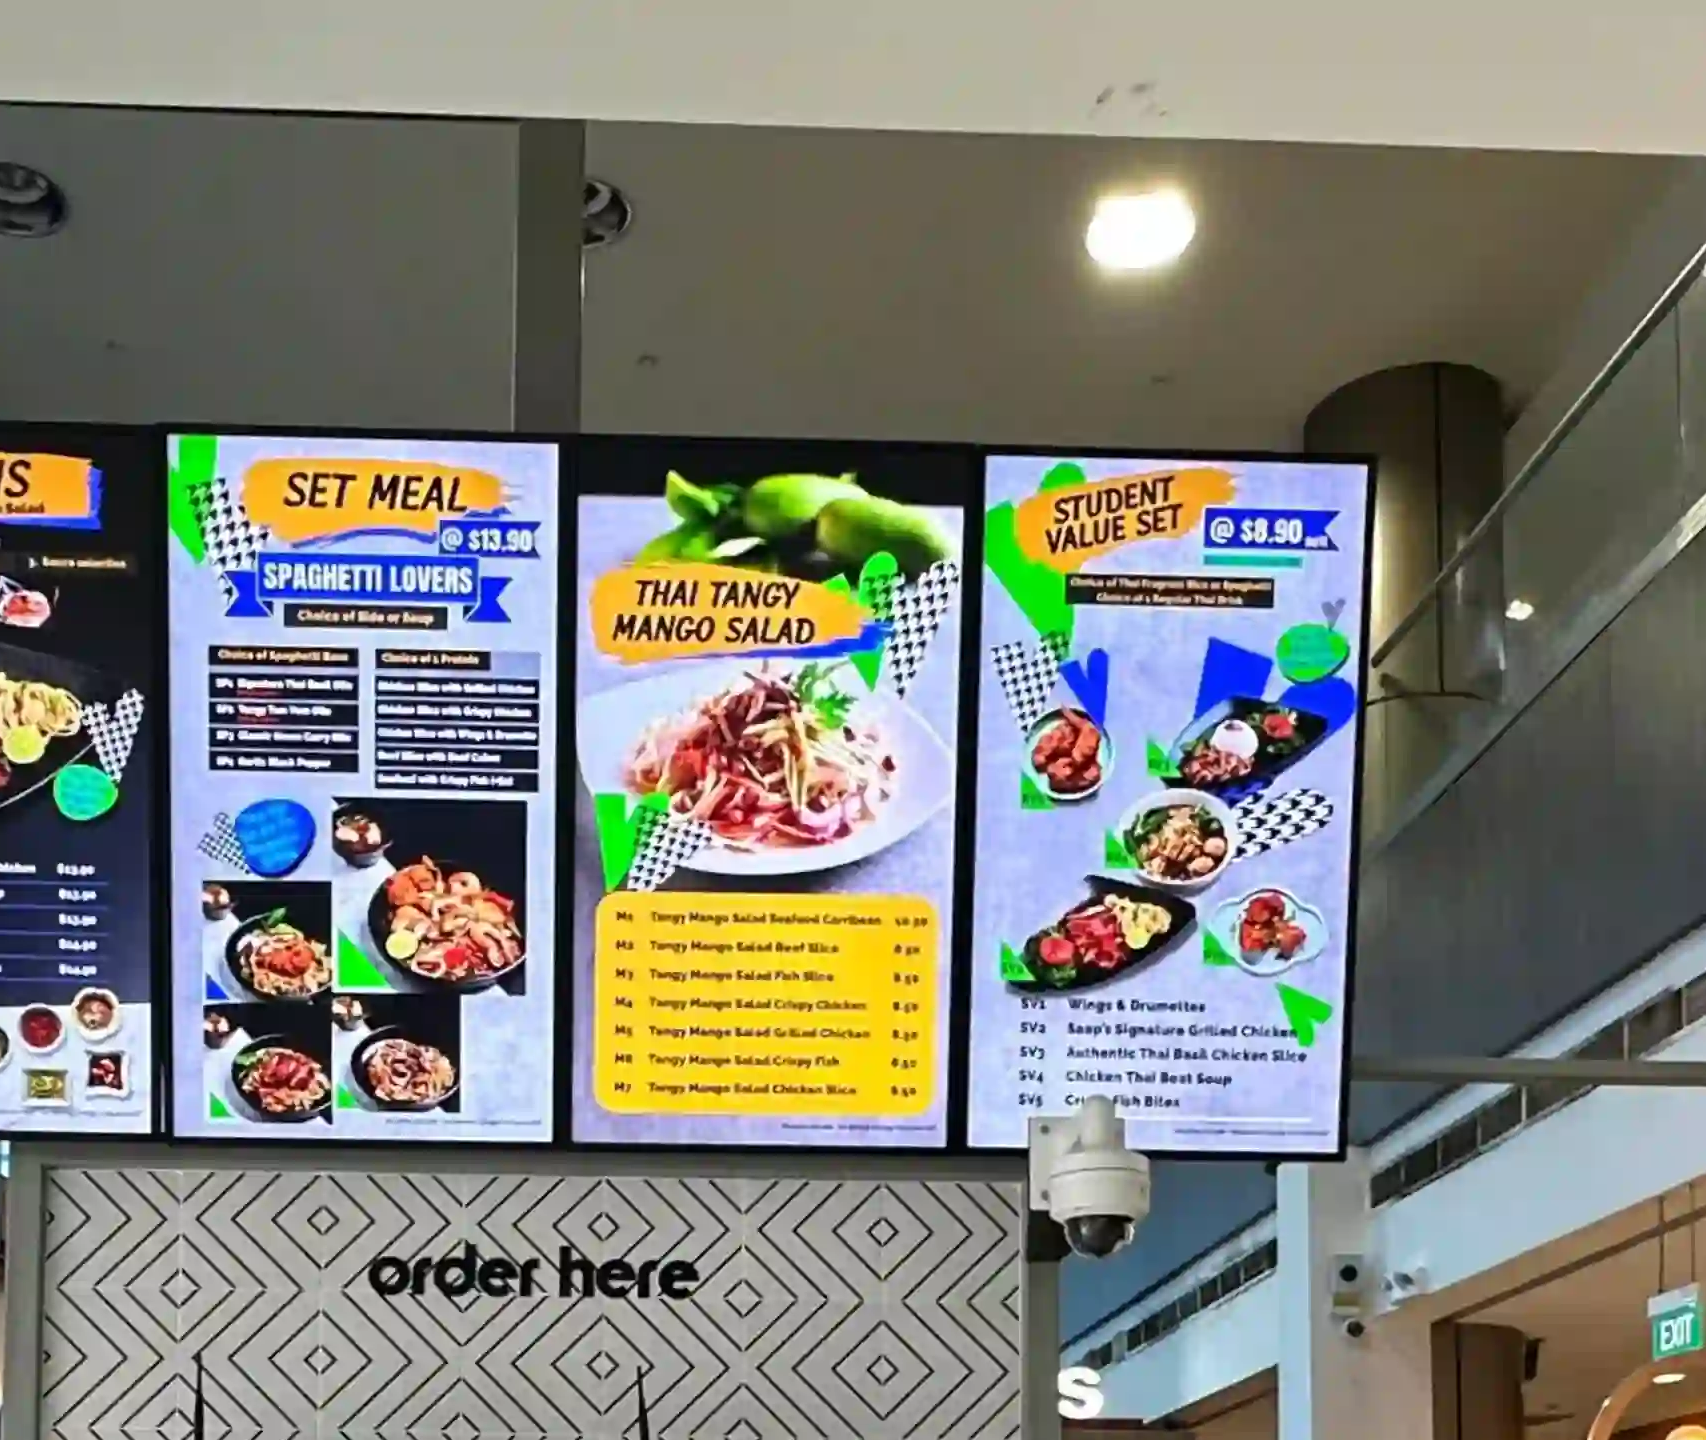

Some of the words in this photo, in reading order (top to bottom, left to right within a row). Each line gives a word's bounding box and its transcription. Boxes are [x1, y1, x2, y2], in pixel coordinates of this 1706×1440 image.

[283, 472, 357, 508] SET
[368, 474, 468, 512] MEAL
[1054, 475, 1175, 525] STUDENT
[442, 529, 464, 550] @
[468, 529, 534, 552] $13.90
[1045, 514, 1126, 555] VALUE
[1137, 504, 1183, 537] SET
[1210, 519, 1234, 543] @
[1241, 518, 1303, 544] $8.90
[262, 563, 382, 592] SPAGHETTI
[390, 566, 473, 594] LOVERS
[636, 580, 698, 607] THAI
[710, 581, 800, 609] TANGY
[613, 615, 716, 642] MANGO
[724, 617, 815, 644] SALAD
[1021, 998, 1046, 1010] SV1
[1068, 999, 1113, 1015] Wings
[1130, 1000, 1206, 1013] Drumettes
[1020, 1022, 1046, 1034] SV2
[1115, 1024, 1185, 1039] Signature
[1189, 1025, 1237, 1038] Grilled
[1241, 1025, 1298, 1038] Chicken
[1020, 1046, 1045, 1059] SV3
[1067, 1047, 1136, 1060] Authentic
[1139, 1048, 1170, 1061] Thai
[1211, 1049, 1267, 1062] Chicken
[1272, 1050, 1307, 1063] Slice
[1019, 1070, 1044, 1083] SV4
[1066, 1071, 1122, 1084] Chicken
[1127, 1072, 1156, 1084] Thai
[1197, 1073, 1232, 1086] Soup
[368, 1243, 540, 1297] order
[559, 1246, 699, 1299] here
